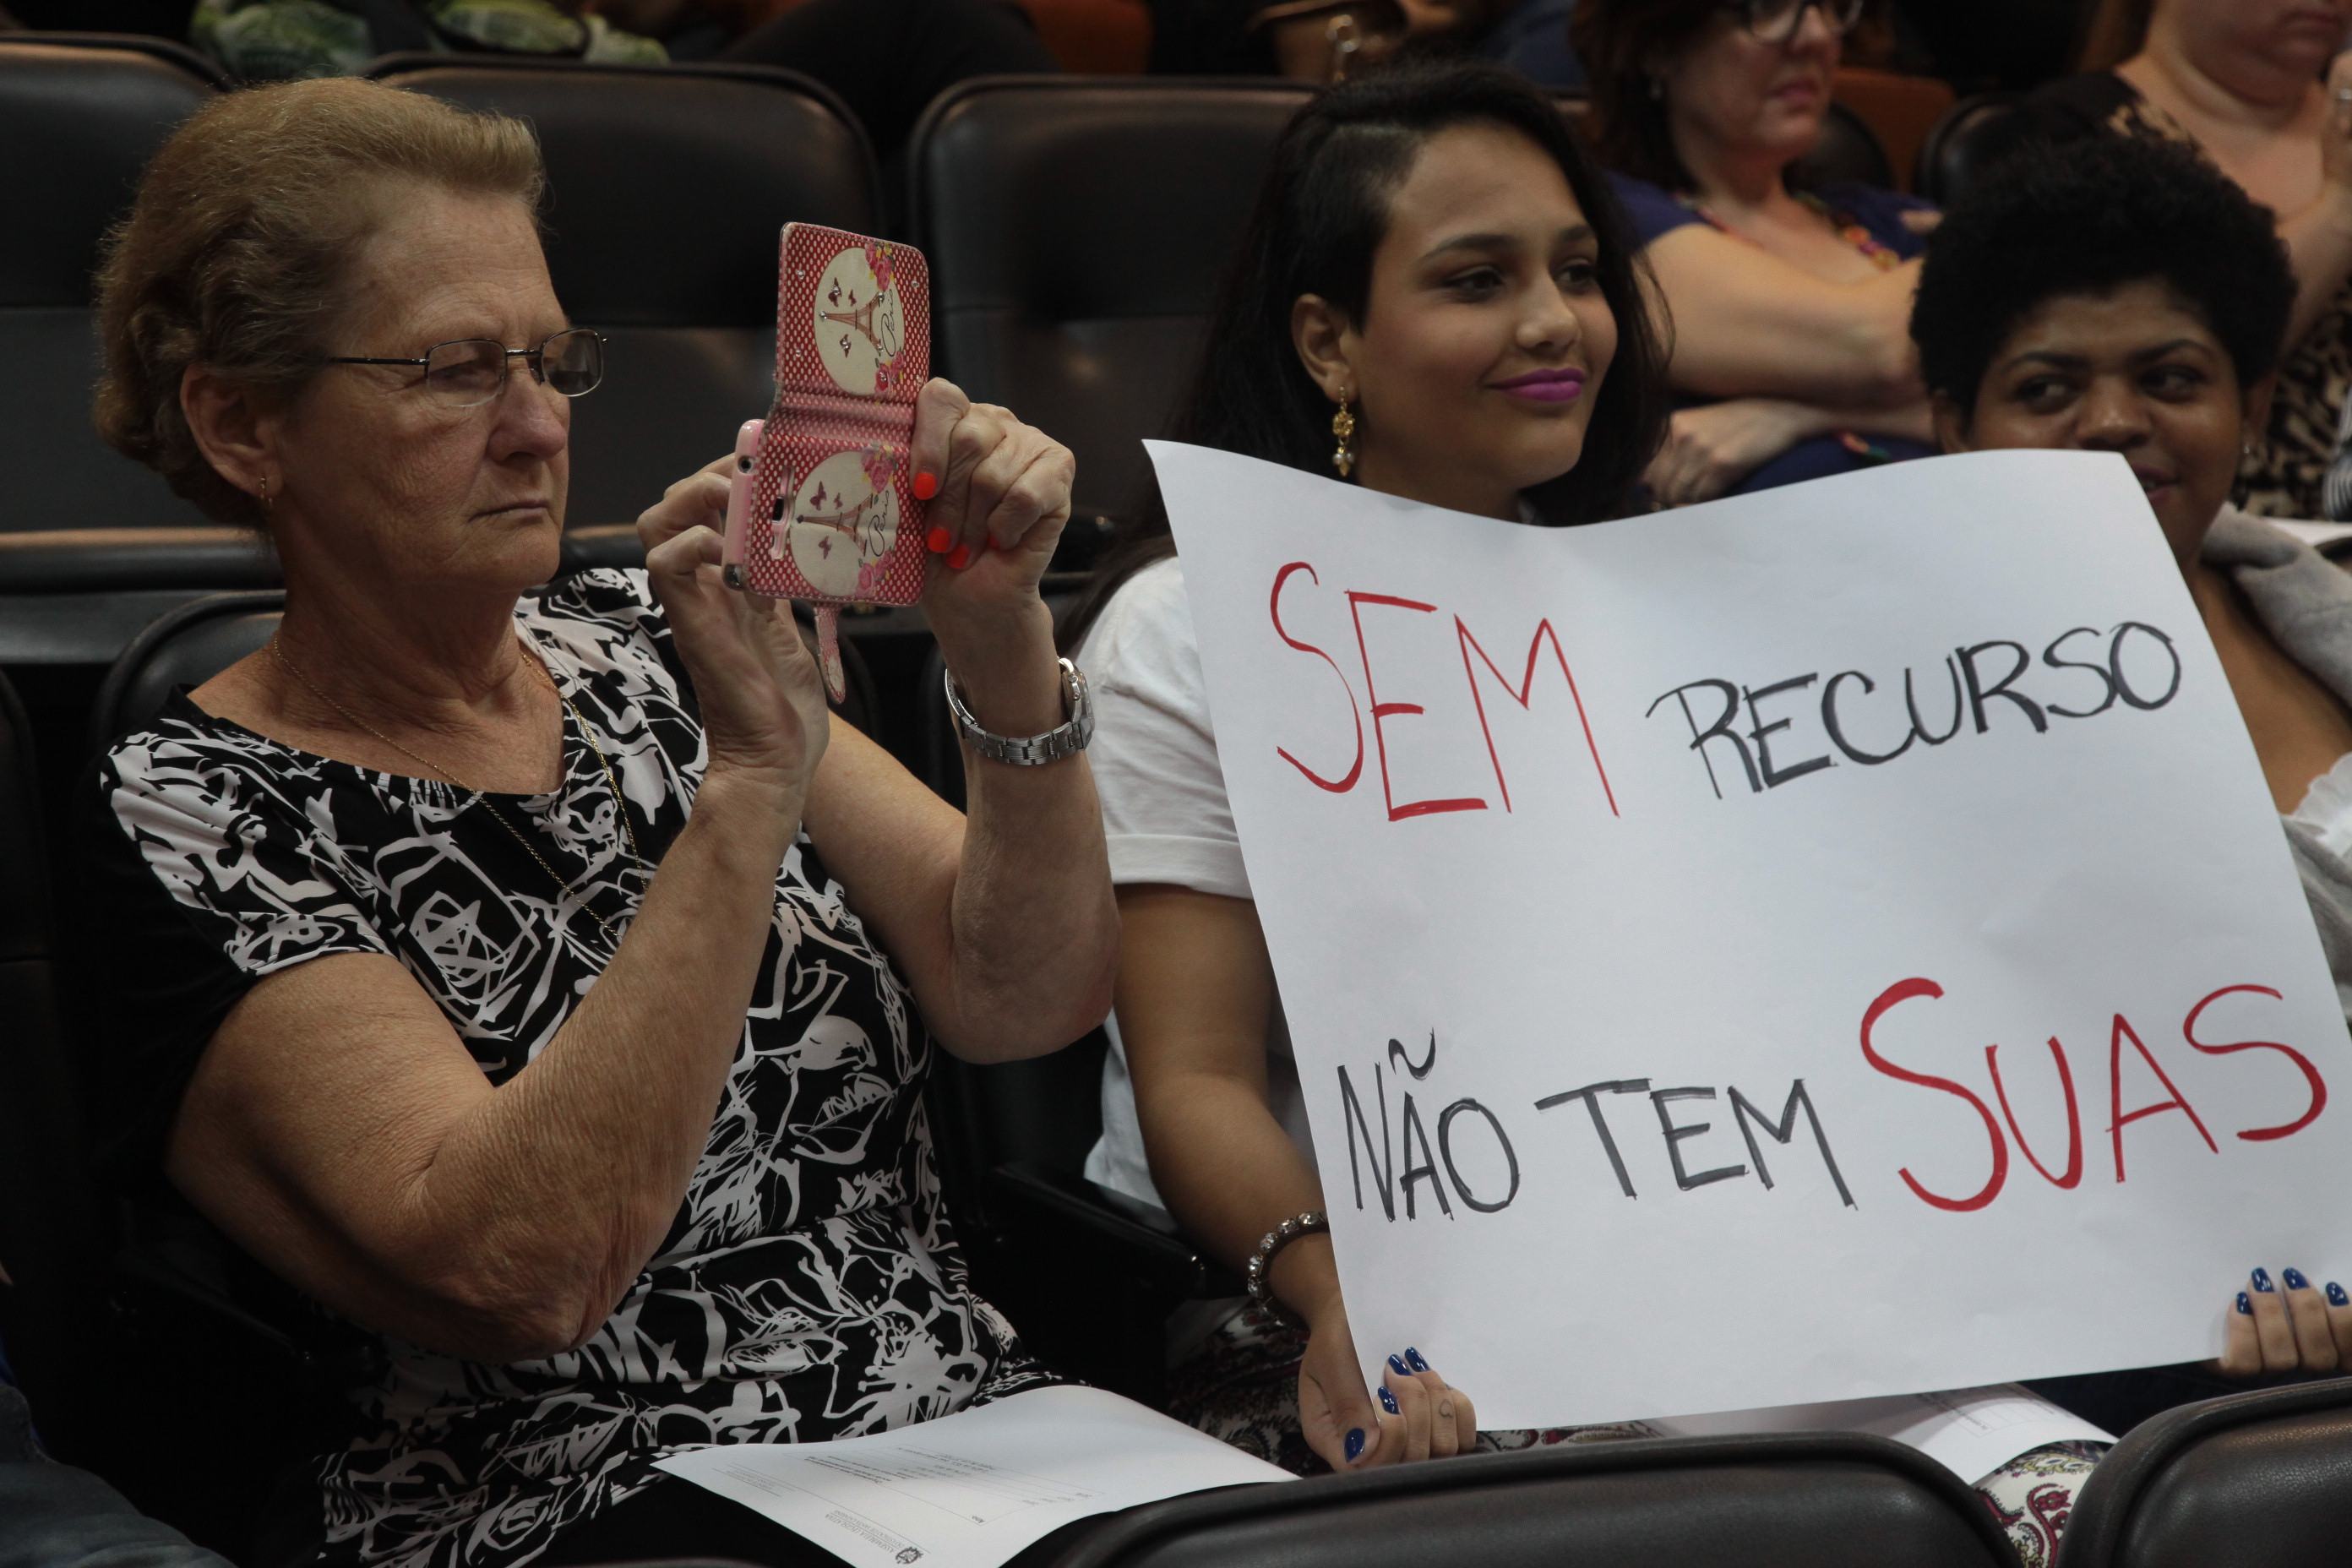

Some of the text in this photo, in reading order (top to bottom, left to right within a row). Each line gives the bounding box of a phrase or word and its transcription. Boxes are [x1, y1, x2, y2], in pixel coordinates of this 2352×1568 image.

[880, 288, 896, 357] Paris
[868, 490, 890, 558] Paris
[1270, 561, 2180, 822] SEM RECURSO
[1337, 977, 2327, 1222] NÃO TEM SUAS
[825, 1513, 895, 1554] ASSEMBLEIA LEGISLATIVA
